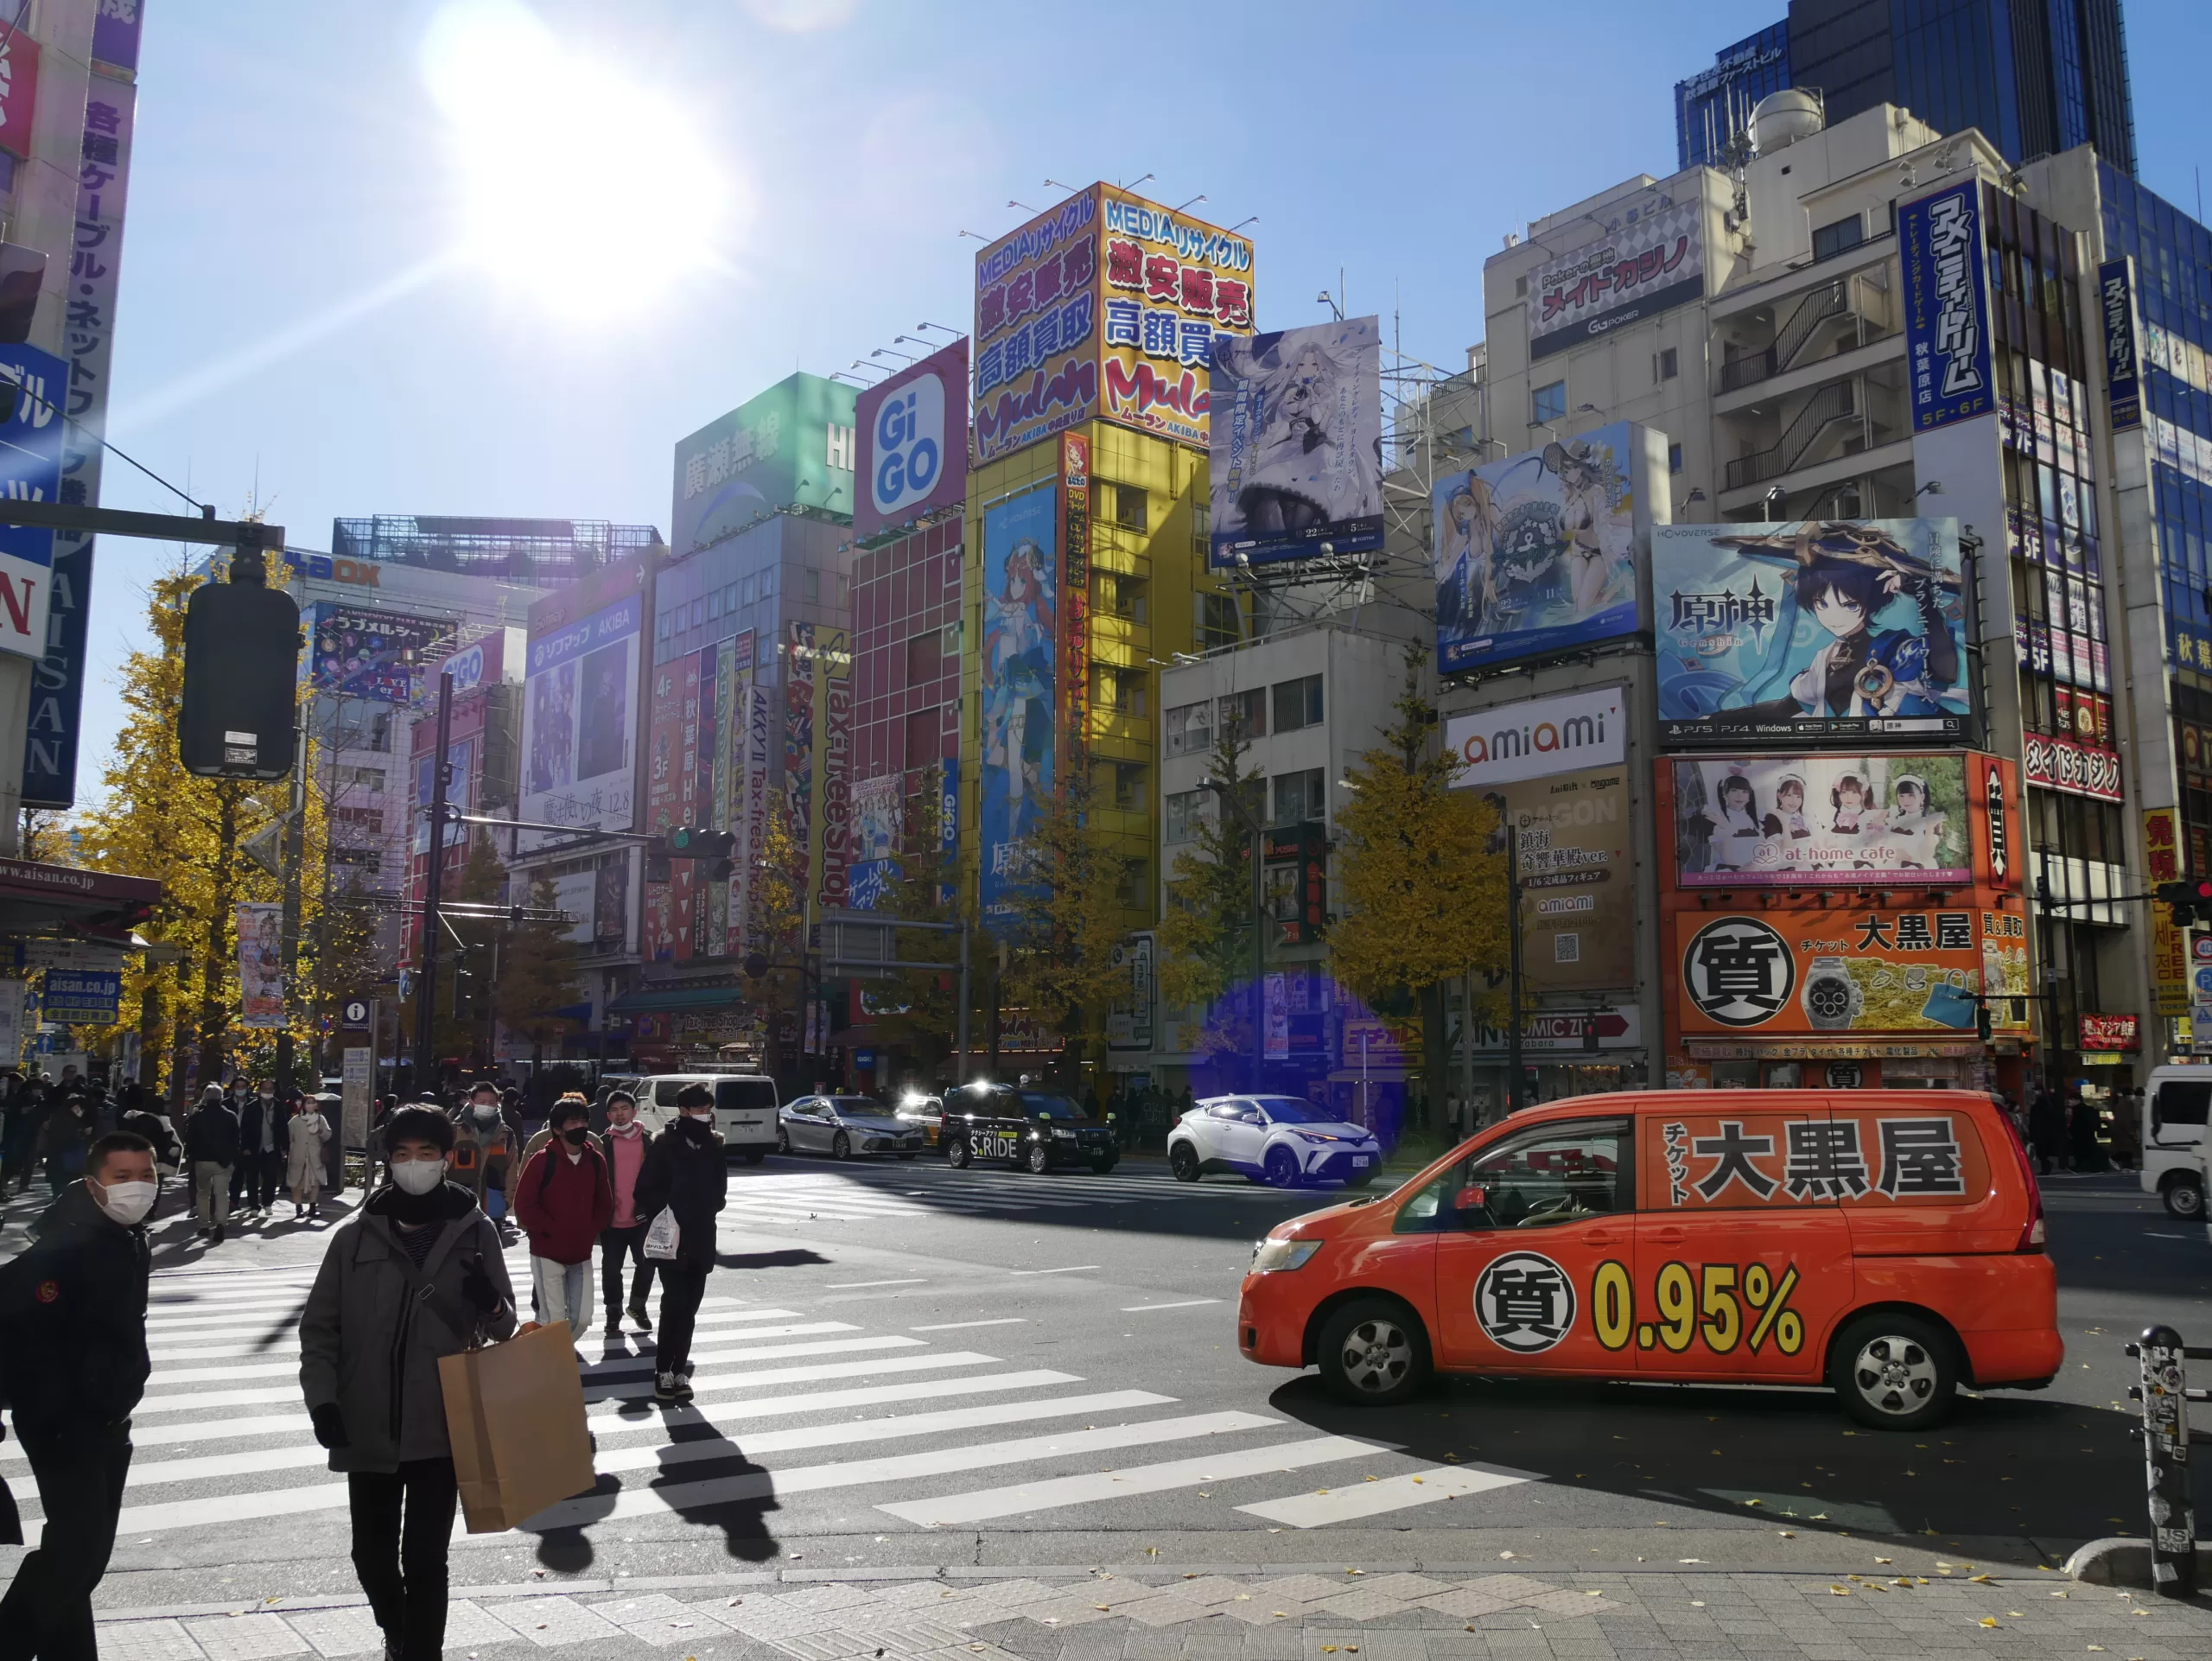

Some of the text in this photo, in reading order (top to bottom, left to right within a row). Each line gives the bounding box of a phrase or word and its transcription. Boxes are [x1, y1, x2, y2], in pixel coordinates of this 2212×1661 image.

[1105, 200, 1249, 271] MEDIAリサイクル
[979, 234, 1094, 338] 激安販売
[1106, 238, 1249, 324] 激安販売
[1542, 235, 1688, 321] メイドカジノ
[977, 290, 1093, 396] 高額買取
[1915, 342, 1932, 404] 秋葉原店
[977, 359, 1096, 459] Mulan
[1021, 424, 1046, 443] AKIBA
[1122, 407, 1166, 430] ムーラン
[1167, 422, 1198, 440] AKIBA
[1068, 489, 1085, 501] DVD
[1071, 523, 1081, 532] CD
[1928, 532, 1943, 609] 冒険に満ちた
[335, 616, 421, 637] ラブメルシー
[546, 608, 630, 659] ソフマップ AKIBA
[1667, 572, 1776, 655] 原神
[1679, 636, 1742, 648] Genshin
[28, 570, 76, 776] AISAN
[657, 673, 671, 697] 4F
[752, 689, 767, 749] AKKY
[1464, 713, 1605, 765] amiami
[1721, 724, 1750, 734] PS4
[1756, 723, 1791, 733] Windows
[653, 754, 669, 781] 3F
[2026, 739, 2120, 793] メイドカジノ
[609, 790, 629, 813] 12.8
[1519, 830, 1551, 851] 鎮海
[1785, 847, 1853, 860] at-home
[1860, 847, 1896, 861] cafe
[2146, 815, 2177, 882] 免税
[1528, 872, 1600, 887] 1/6 完成品フィギュア
[1538, 895, 1594, 913] amiami
[1802, 939, 1849, 952] チケット
[1855, 913, 1973, 951] 大黒屋
[2171, 931, 2185, 979] FREE
[50, 978, 116, 996] aisan.co.jp
[1698, 932, 1787, 1013] 質
[970, 1136, 1018, 1159] S.RIDE
[1663, 1123, 1690, 1206] チケット
[1692, 1116, 1967, 1202] 大黒屋
[1486, 1266, 1563, 1340] 質
[1591, 1259, 1806, 1358] 0.95%
